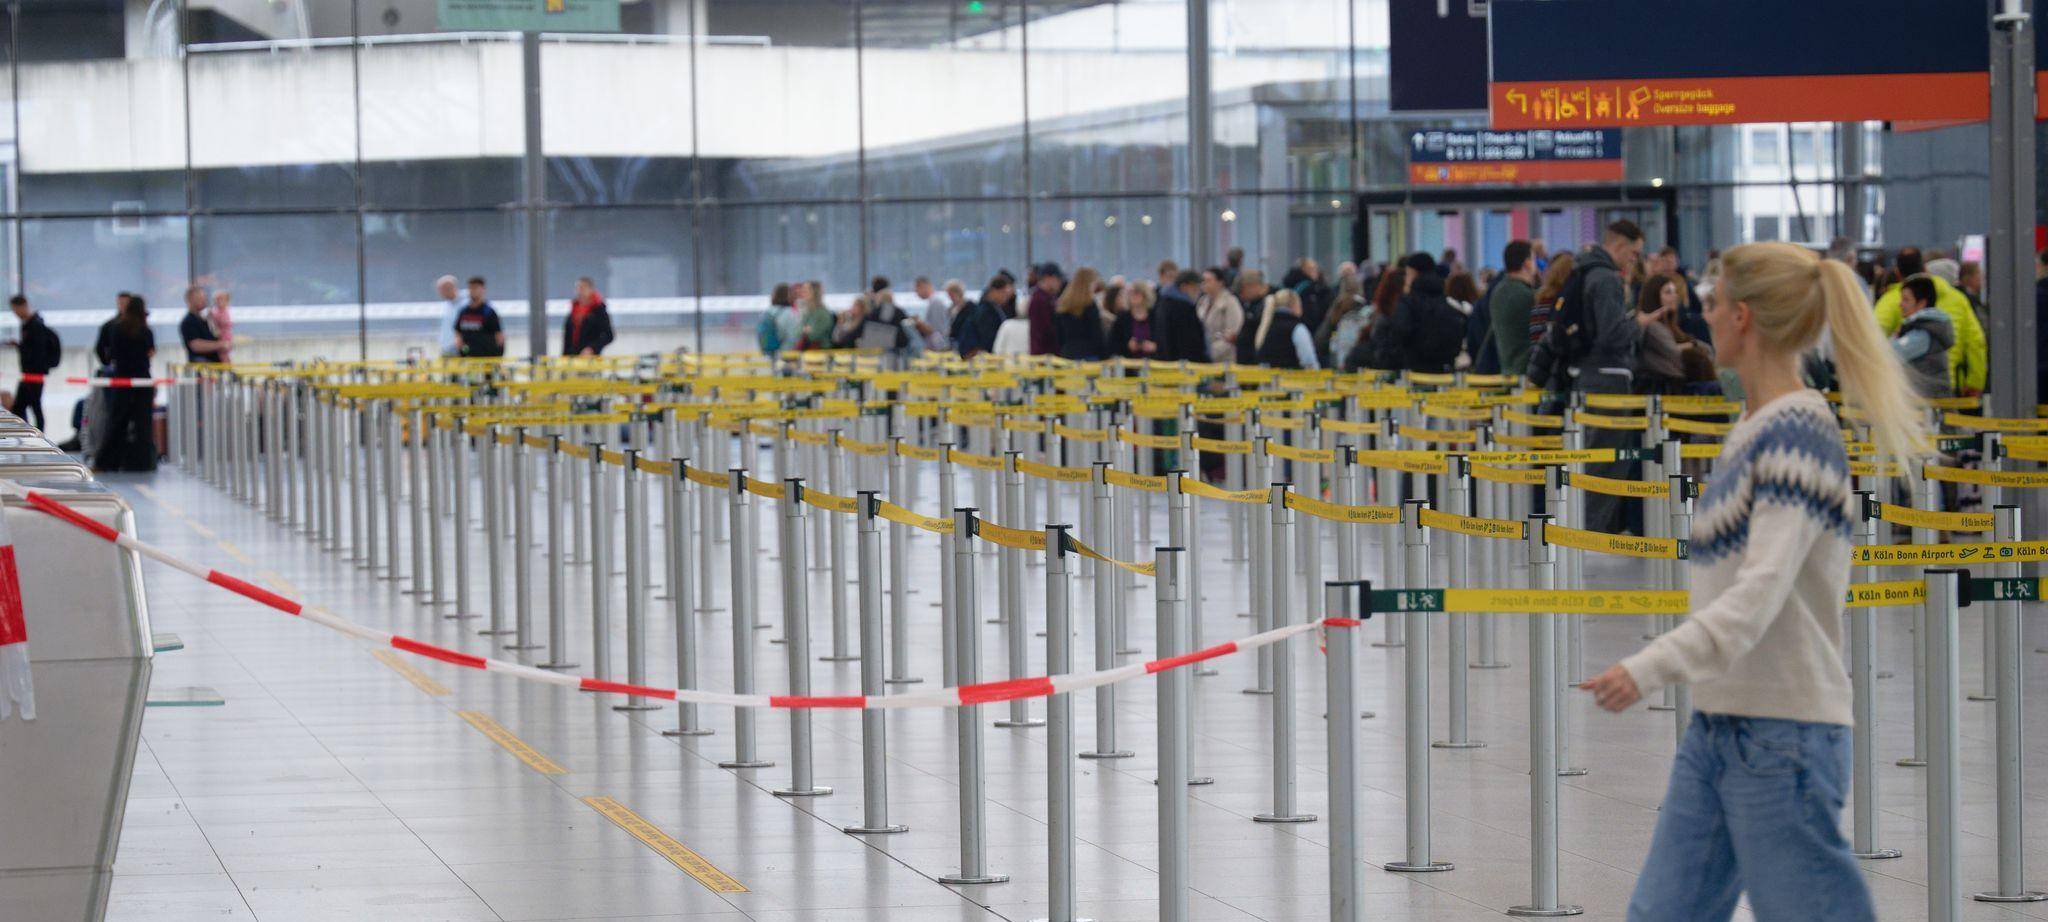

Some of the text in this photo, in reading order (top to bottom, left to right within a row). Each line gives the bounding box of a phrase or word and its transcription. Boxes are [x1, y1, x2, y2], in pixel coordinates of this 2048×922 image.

[1874, 549, 1954, 561] Köln Bonn Airport
[2017, 546, 2037, 556] Köln
[1858, 590, 1881, 601] Köln
[1885, 588, 1909, 599] Bonn
